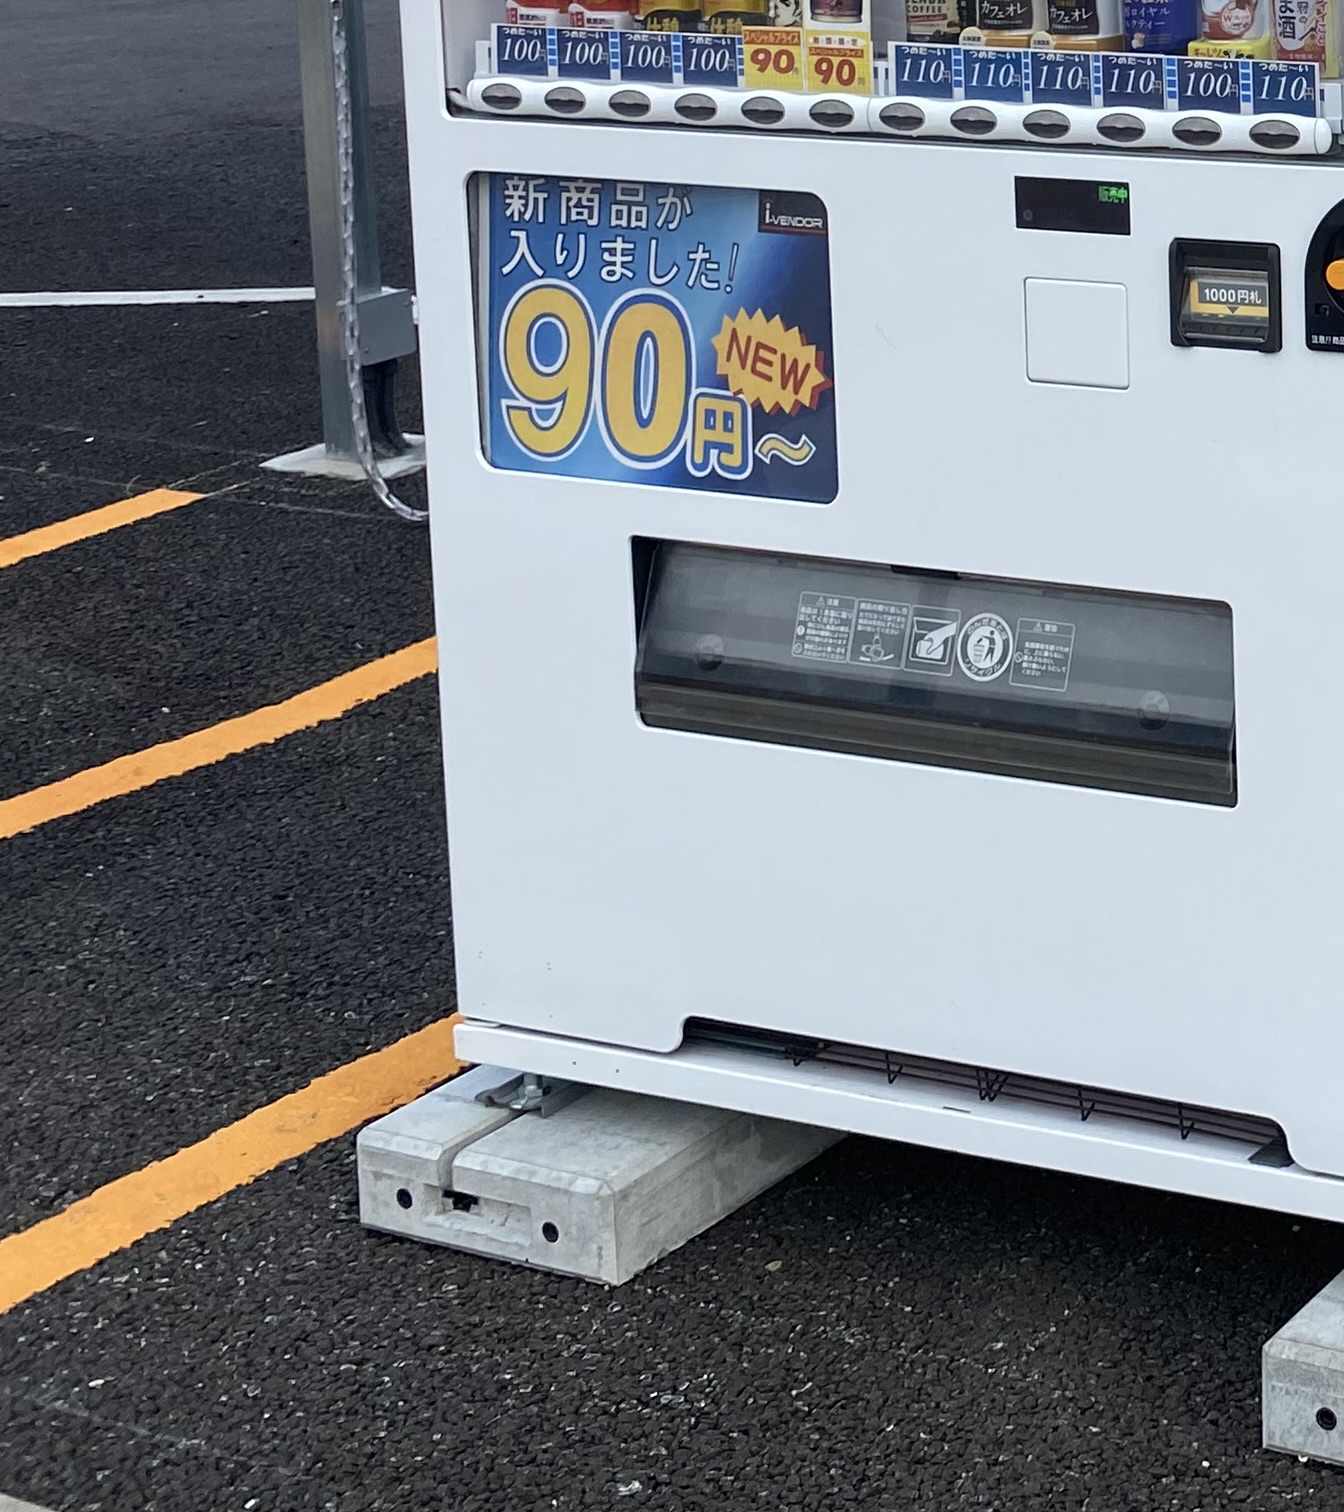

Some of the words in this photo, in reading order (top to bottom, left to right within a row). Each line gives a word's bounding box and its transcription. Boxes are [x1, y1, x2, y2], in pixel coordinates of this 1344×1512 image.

[981, 1, 1028, 18] カフェオレ
[1050, 4, 1093, 20] カフェオレ
[504, 176, 693, 230] 新商品が
[501, 230, 740, 294] 入りました!
[1203, 287, 1262, 304] 1000円札
[726, 327, 811, 396] NEW
